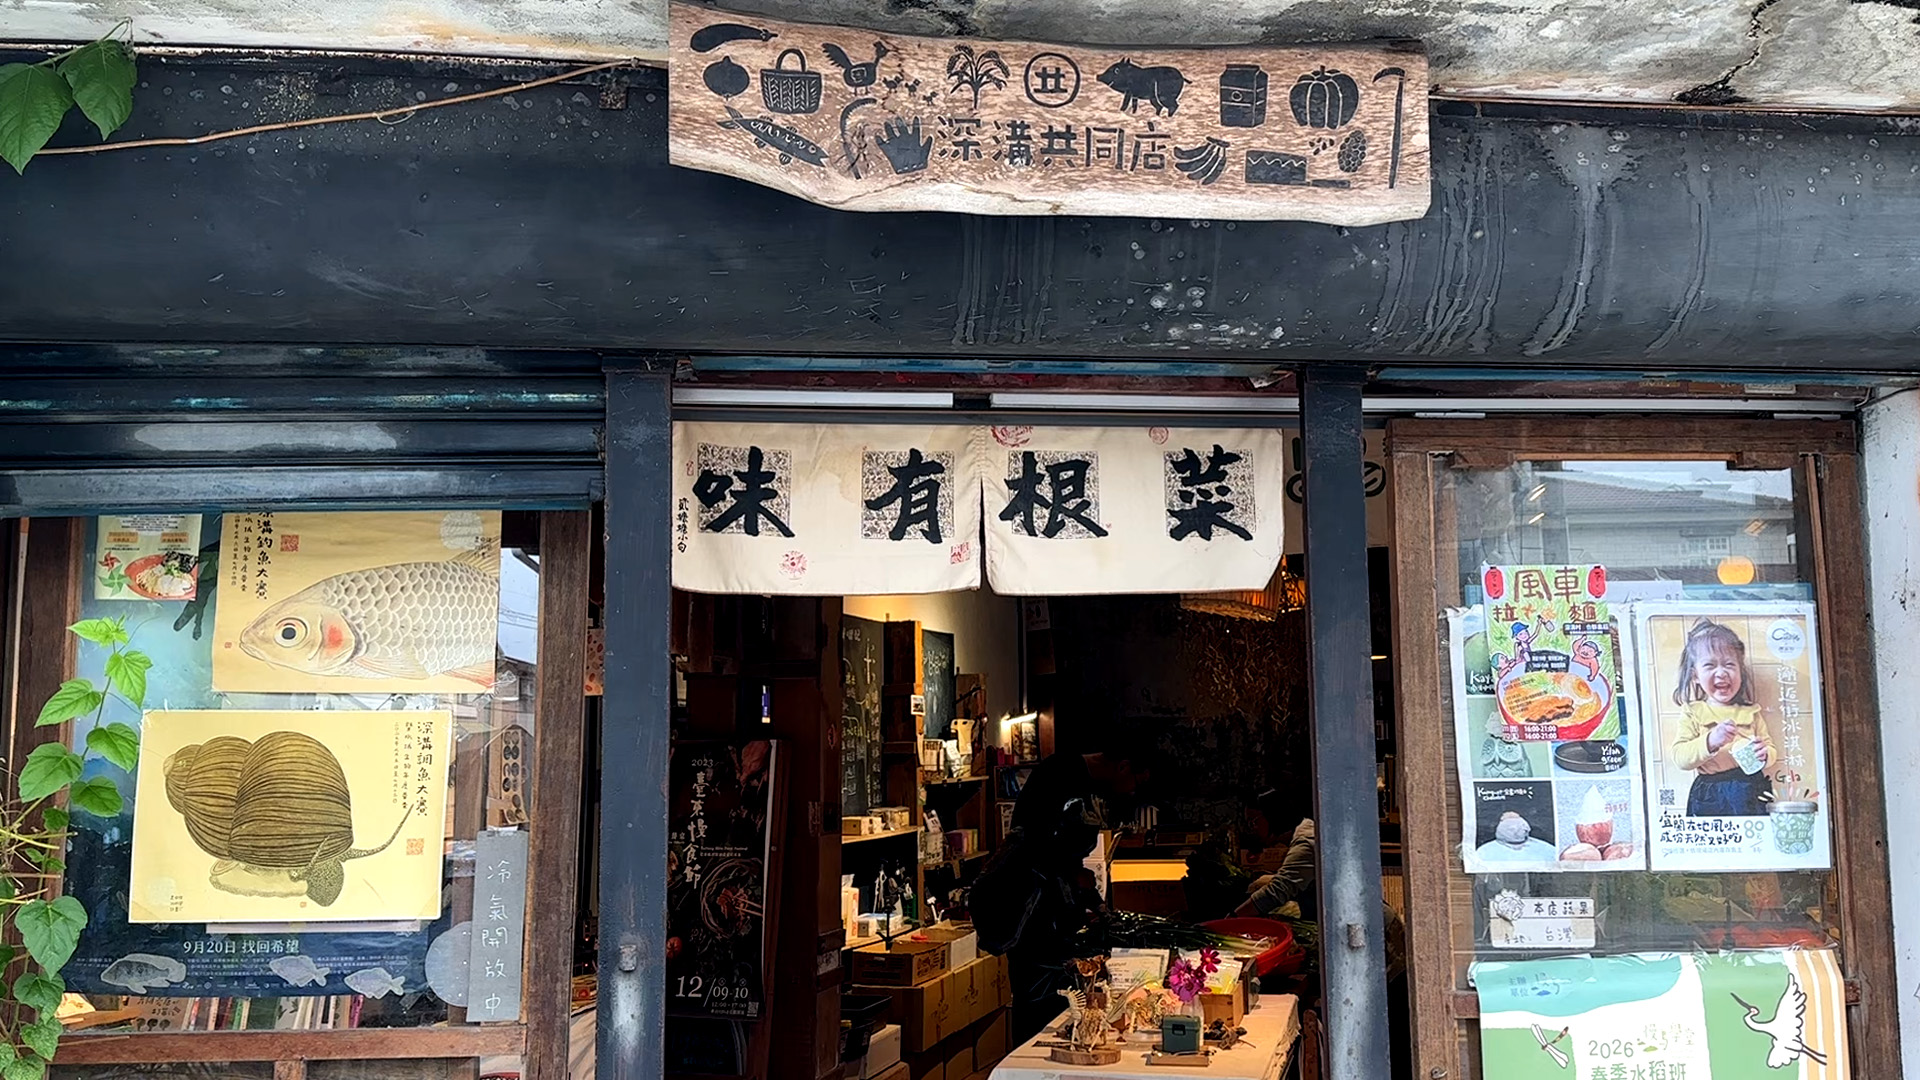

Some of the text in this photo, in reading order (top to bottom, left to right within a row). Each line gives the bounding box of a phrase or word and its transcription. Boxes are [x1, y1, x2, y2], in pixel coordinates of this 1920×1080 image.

[938, 116, 1171, 171] 深溝共同店
[1514, 566, 1582, 603] 風車
[691, 759, 714, 768] 2023
[183, 939, 300, 955] 9月20日 找回希望
[481, 860, 511, 1016] 冷氣開放中
[1588, 1039, 1634, 1059] 2026
[1591, 1060, 1686, 1080] 春季水稻班
